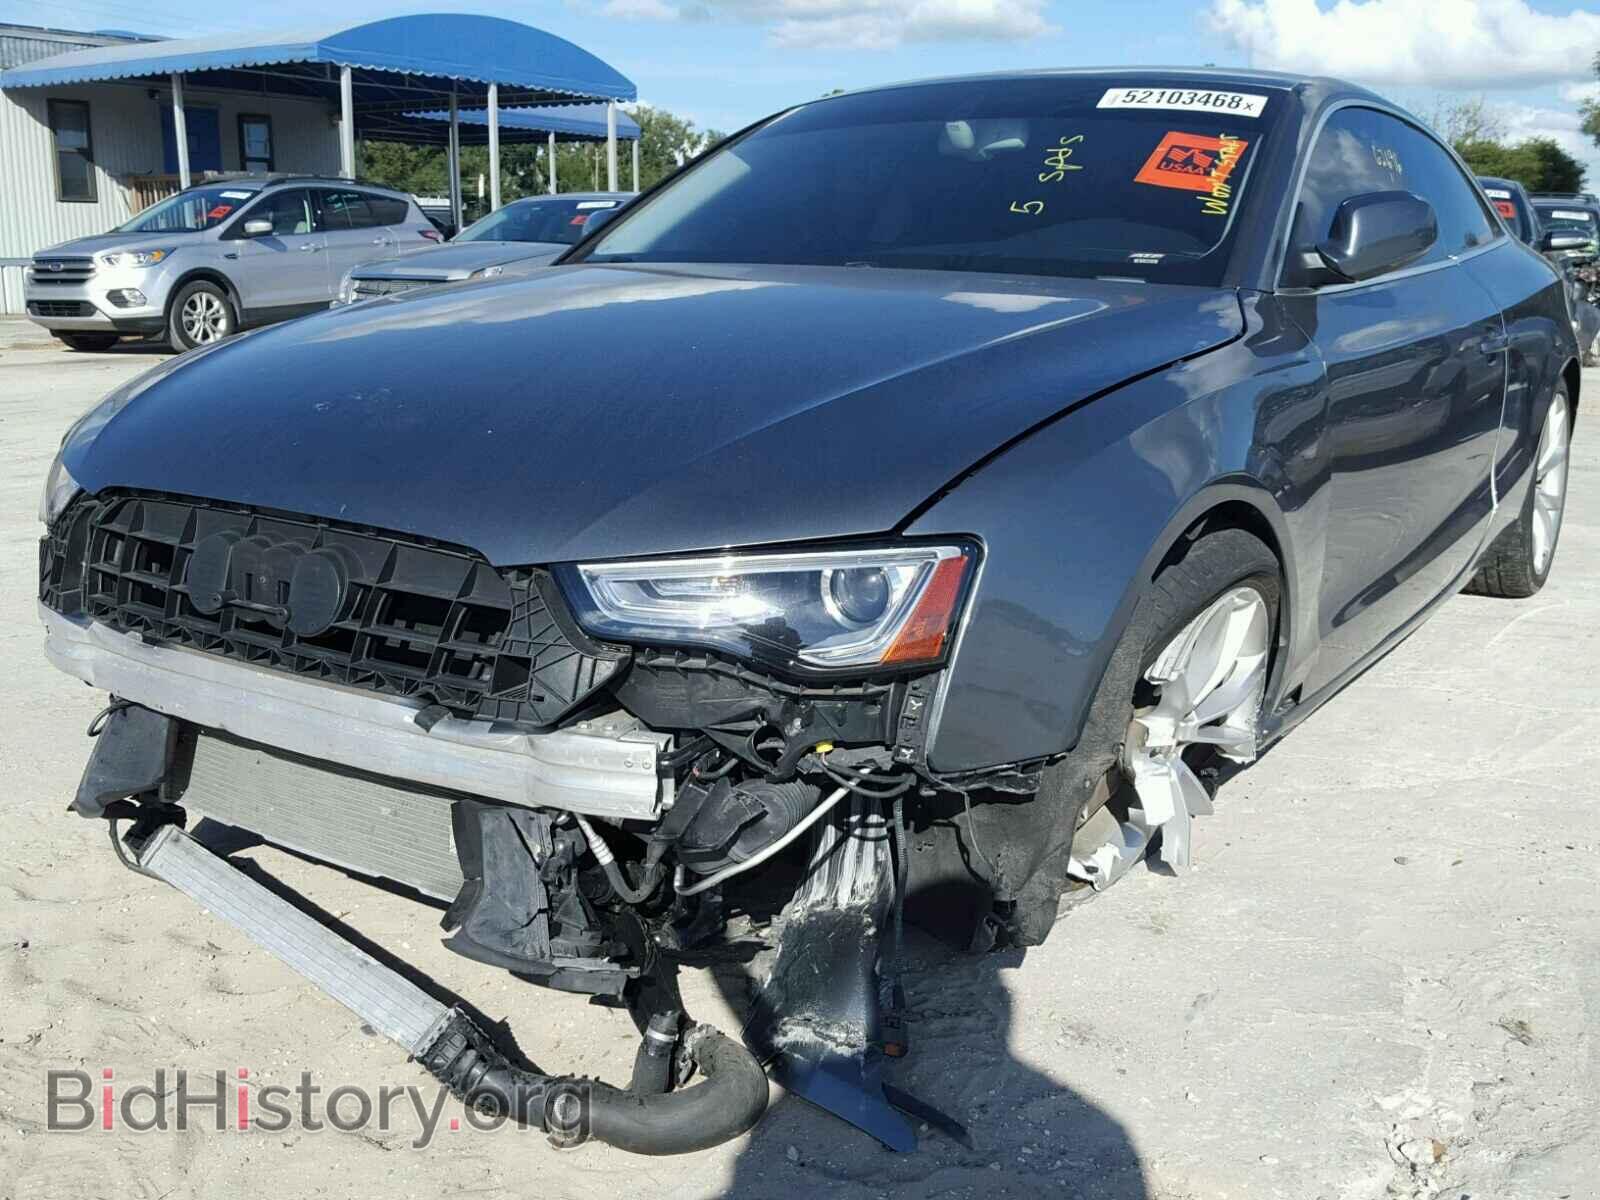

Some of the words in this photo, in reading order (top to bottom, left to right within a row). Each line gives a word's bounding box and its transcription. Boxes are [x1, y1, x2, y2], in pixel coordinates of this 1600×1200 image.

[1122, 90, 1243, 110] 52103468
[1159, 161, 1205, 176] USAA
[1010, 200, 1044, 215] 5
